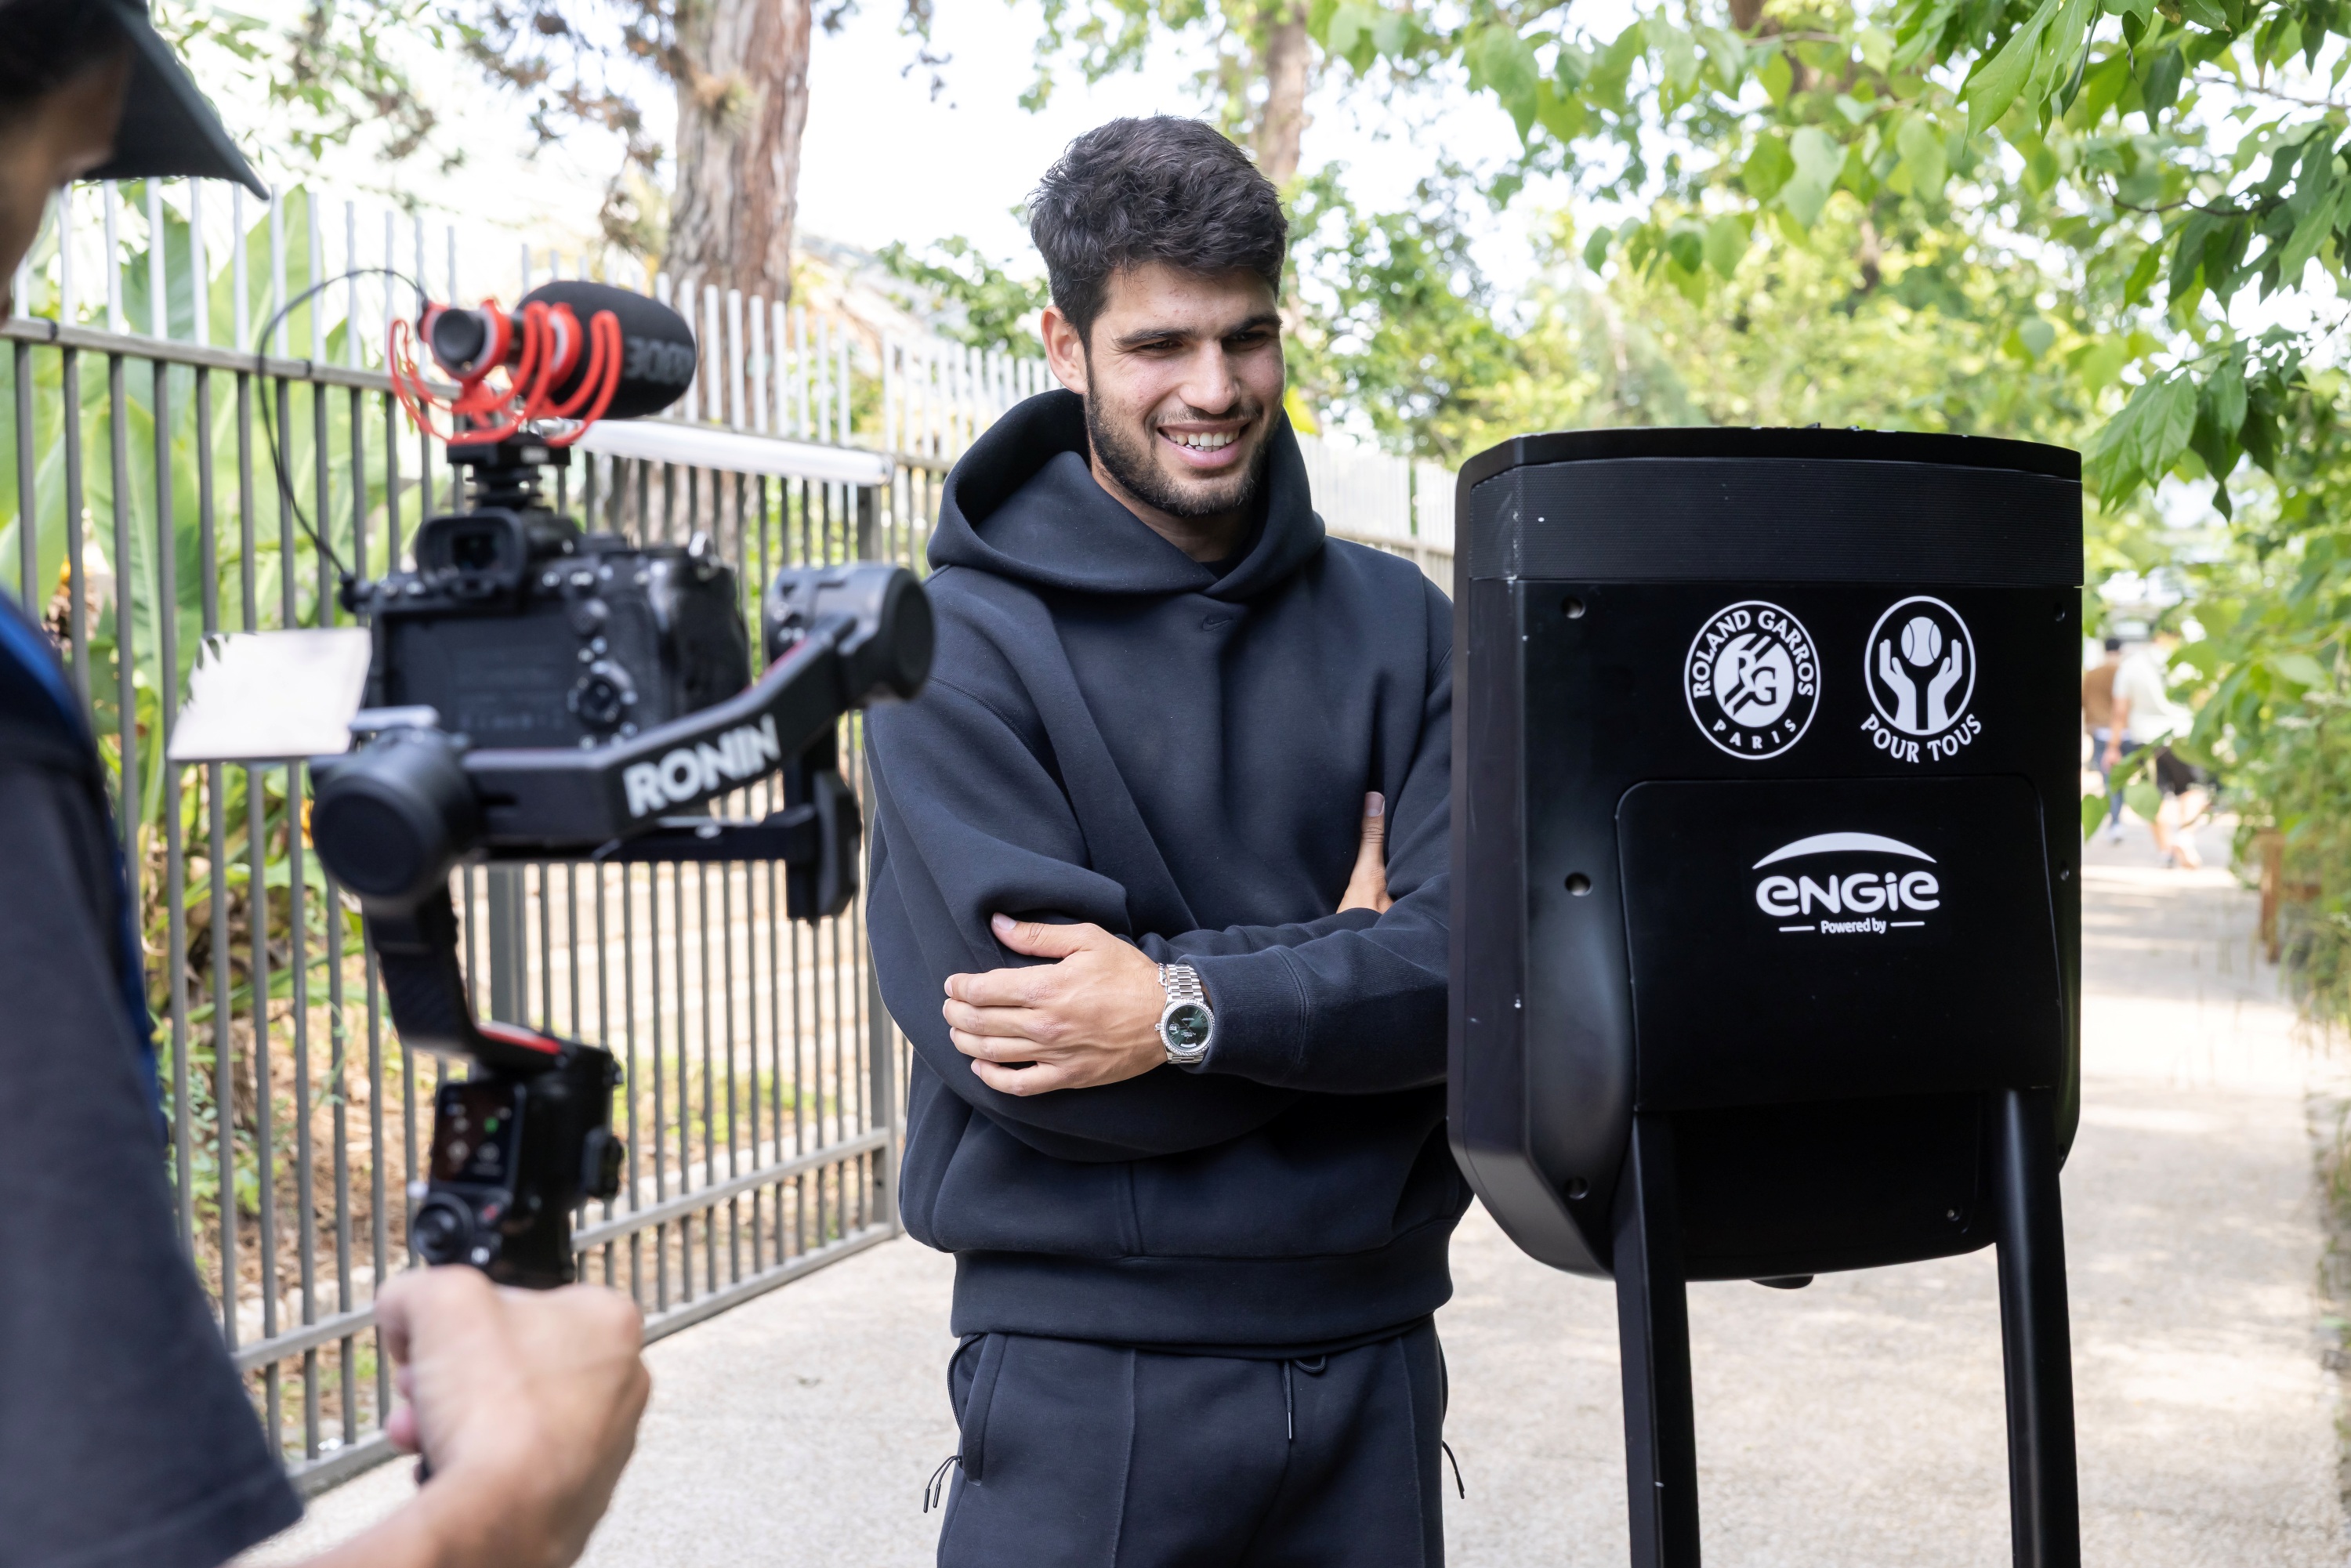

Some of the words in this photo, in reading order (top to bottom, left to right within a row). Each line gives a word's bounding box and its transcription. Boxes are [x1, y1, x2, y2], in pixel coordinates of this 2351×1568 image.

[1692, 610, 1751, 698] ROLAND
[1758, 610, 1814, 697] GARROS
[1712, 719, 1797, 749] PARIS
[1860, 713, 1920, 763] POUR
[1926, 713, 1982, 762] TOUS
[622, 713, 781, 818] RONIN
[1820, 918, 1871, 934] Powered
[1871, 917, 1887, 934] by
